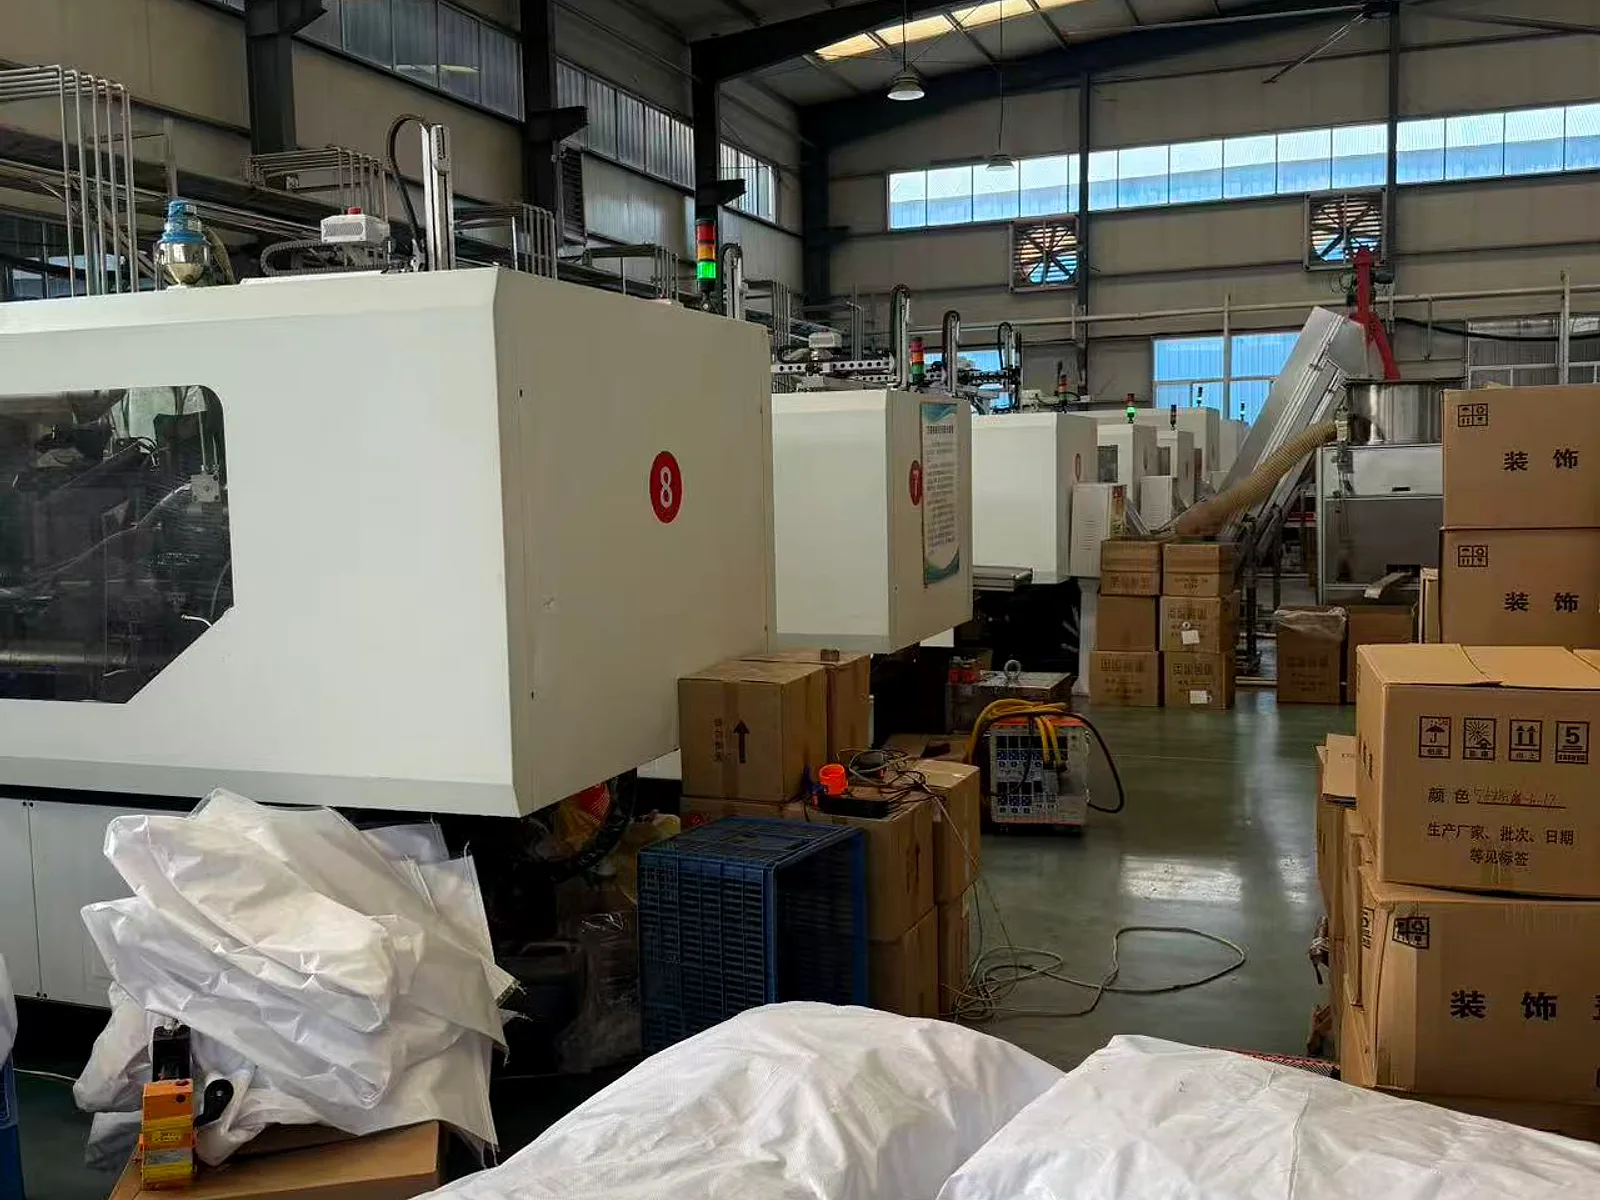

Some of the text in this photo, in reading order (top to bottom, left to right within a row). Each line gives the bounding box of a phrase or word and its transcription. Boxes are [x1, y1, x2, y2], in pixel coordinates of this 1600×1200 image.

[1504, 449, 1580, 472] 装饰
[660, 466, 673, 508] 8
[1504, 592, 1580, 613] 装饰
[1565, 726, 1581, 745] 5
[1428, 786, 1470, 804] 颜色
[1469, 847, 1529, 867] 等见标签
[1450, 990, 1600, 1021] 装饰
